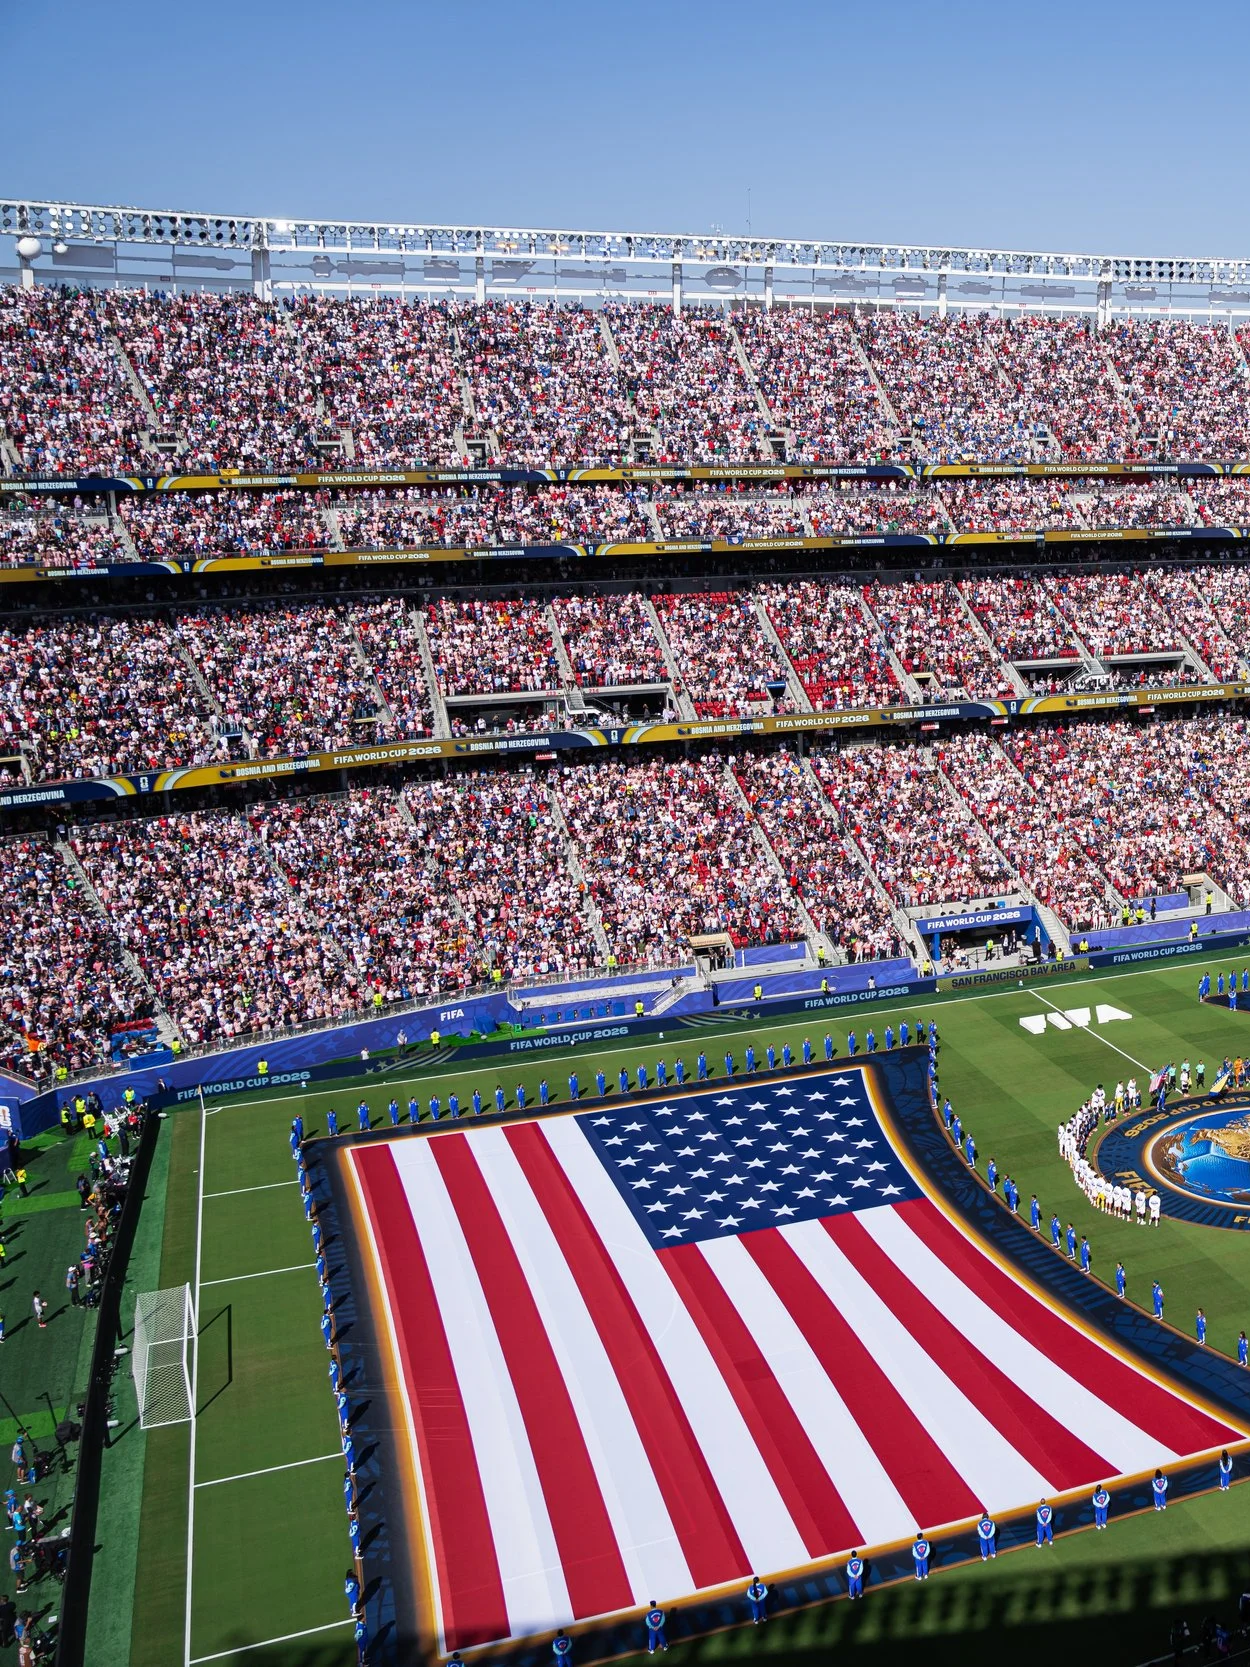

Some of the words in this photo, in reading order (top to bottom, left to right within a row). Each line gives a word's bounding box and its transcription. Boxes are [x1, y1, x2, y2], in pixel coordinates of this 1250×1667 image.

[1164, 691, 1186, 699] WORLD
[1187, 690, 1201, 698] CUP
[1201, 689, 1224, 697] 2026
[776, 719, 793, 729] FIFA
[794, 717, 823, 727] WORLD
[825, 716, 841, 725] CUP
[841, 714, 869, 724] 2026
[894, 710, 912, 719] BOSNIA
[914, 710, 925, 718] AND
[926, 708, 960, 717] HERZEGOVINA
[691, 725, 712, 734] BOSNIA
[714, 724, 725, 733] AND
[726, 722, 764, 732] HERZEGOVINA
[471, 741, 492, 751] BOSNIA
[494, 740, 507, 749] AND
[509, 738, 550, 748] HERZEGOVINA
[334, 754, 354, 765] FIFA
[355, 751, 387, 763] WORLD
[389, 749, 407, 759] CUP
[408, 746, 442, 757] 2026
[236, 765, 260, 777] BOSNIA
[262, 764, 276, 774] AND
[277, 759, 320, 772] HERZEGOVINA
[13, 790, 65, 804] HERZEGOVINA
[927, 920, 944, 929] FIFA
[946, 917, 974, 927] WORLD
[976, 915, 992, 924] CUP
[993, 911, 1020, 922] 2026
[1113, 953, 1130, 963] FIFA
[1131, 949, 1157, 960] WORLD
[1158, 947, 1175, 957] CUP
[1176, 943, 1202, 954] 2026
[952, 977, 972, 987] SAN
[974, 969, 1028, 984] FRANCISCO
[1031, 966, 1049, 976] BAY
[1051, 962, 1075, 973] AREA
[804, 998, 824, 1008] FIFA
[825, 993, 858, 1005] WORLD
[860, 991, 876, 1001] CUP
[878, 987, 909, 999] 2026
[441, 1009, 464, 1021] FIFA
[510, 1039, 532, 1050] FIFA
[533, 1034, 570, 1047] WORLD
[572, 1031, 592, 1042] CUP
[593, 1026, 629, 1039] 2026
[177, 1088, 202, 1101] FIFA
[203, 1082, 244, 1097] WORLD
[247, 1078, 269, 1090] CUP
[271, 1071, 310, 1086] 2026
[1170, 1104, 1200, 1116] CUP
[1124, 1113, 1170, 1138] 2026
